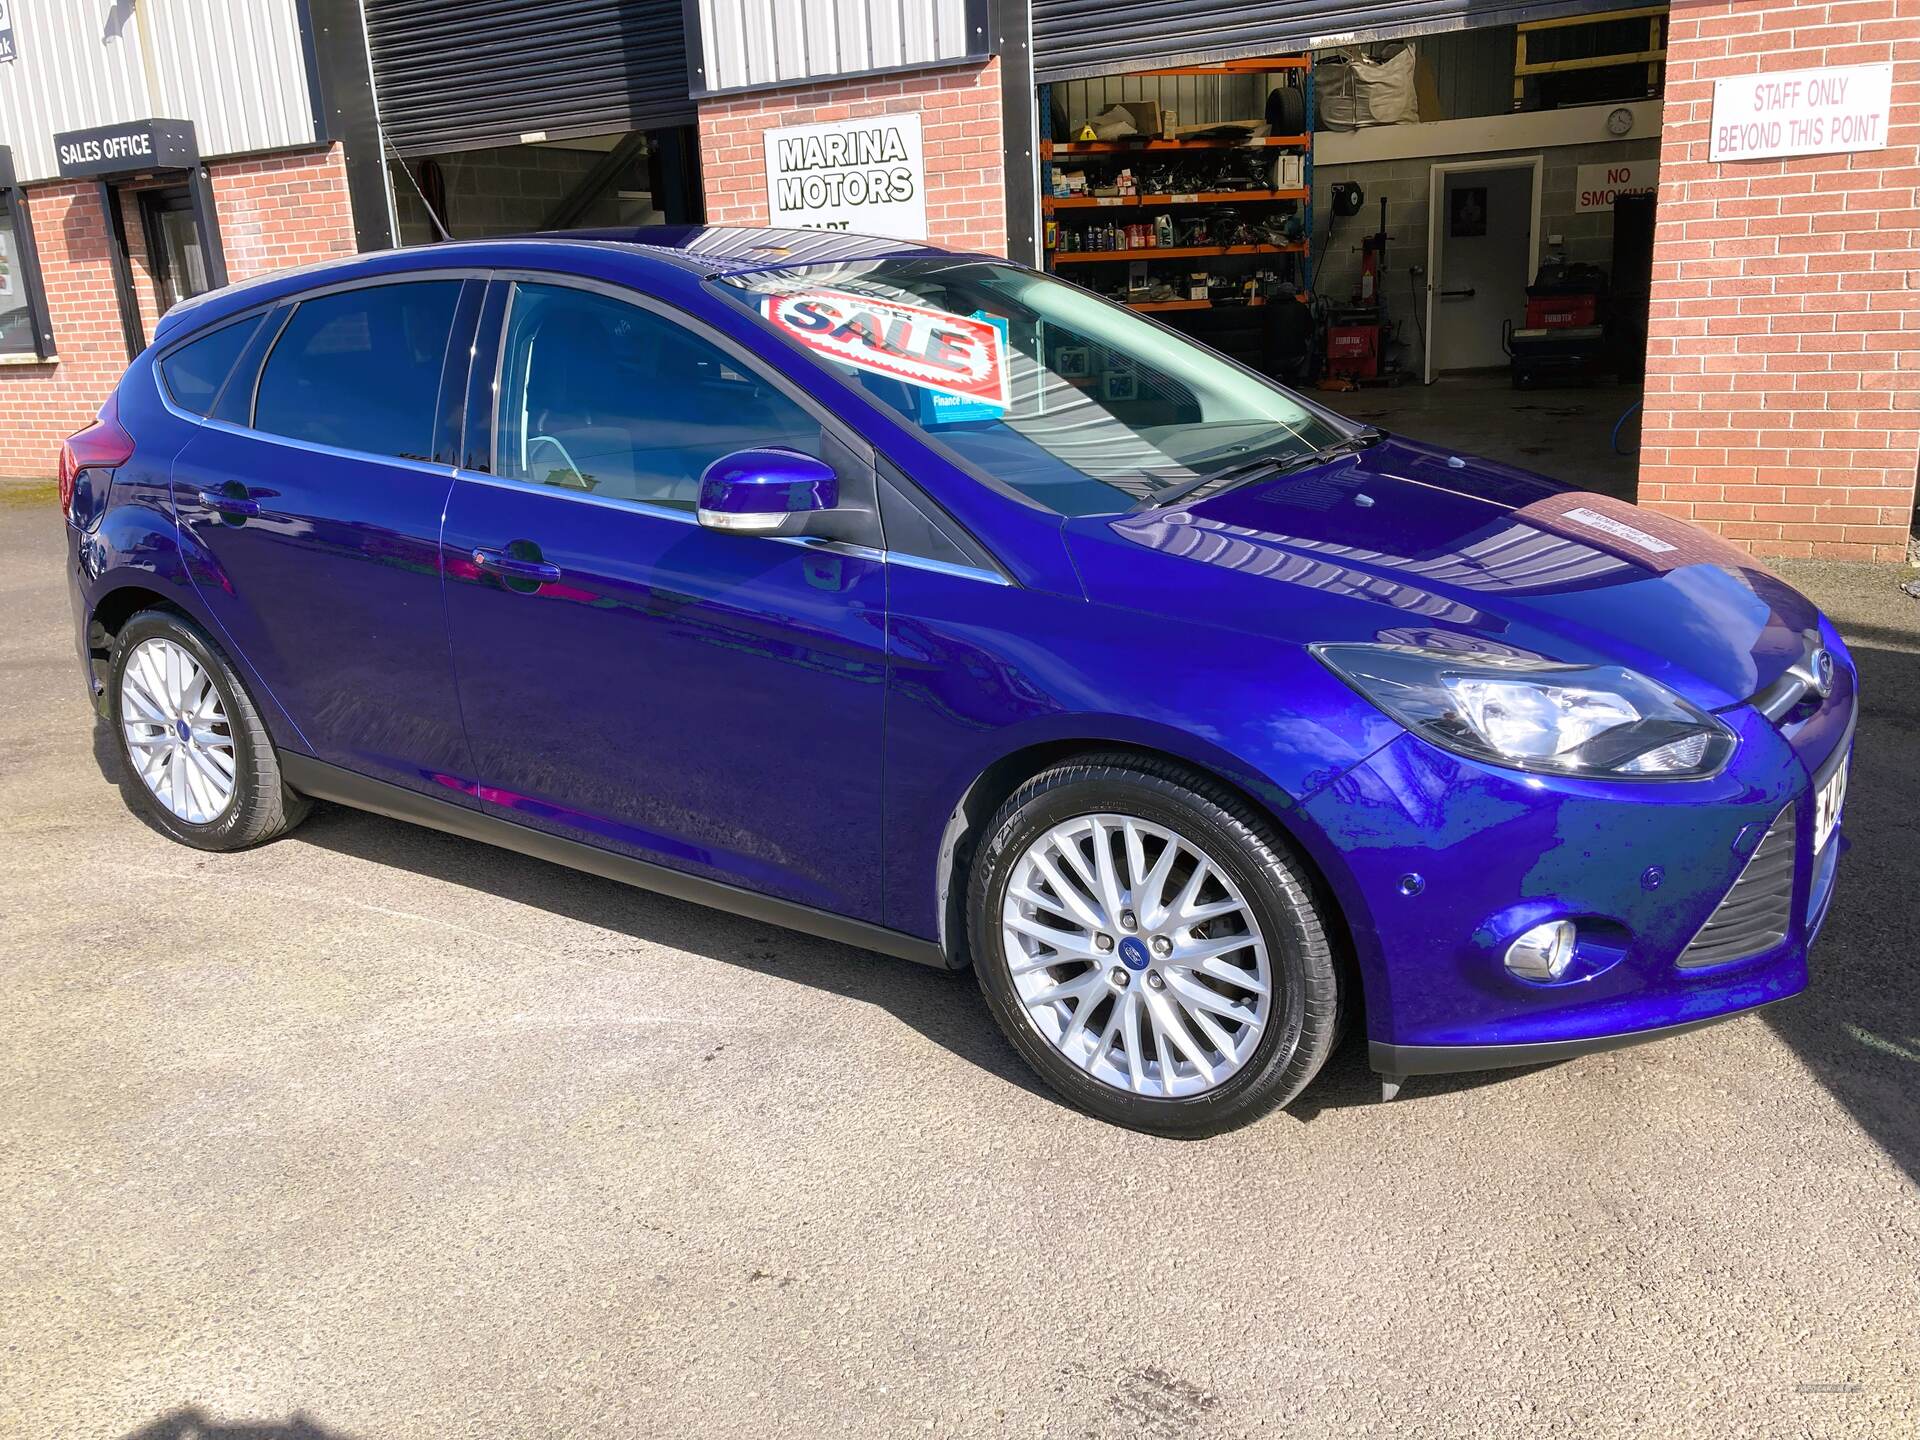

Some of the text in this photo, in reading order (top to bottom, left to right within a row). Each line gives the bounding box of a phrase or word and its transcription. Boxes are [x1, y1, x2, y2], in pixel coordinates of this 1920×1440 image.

[1753, 77, 1849, 112] STAFF ONLY
[60, 134, 152, 165] SALES OFFICE
[777, 127, 908, 172] MARINA
[1717, 113, 1881, 153] BEYOND THIS POINT
[777, 166, 914, 211] MOTORS
[1607, 168, 1631, 185] NO
[849, 302, 913, 322] FOR
[784, 301, 976, 377] SALE
[933, 395, 961, 407] Finance
